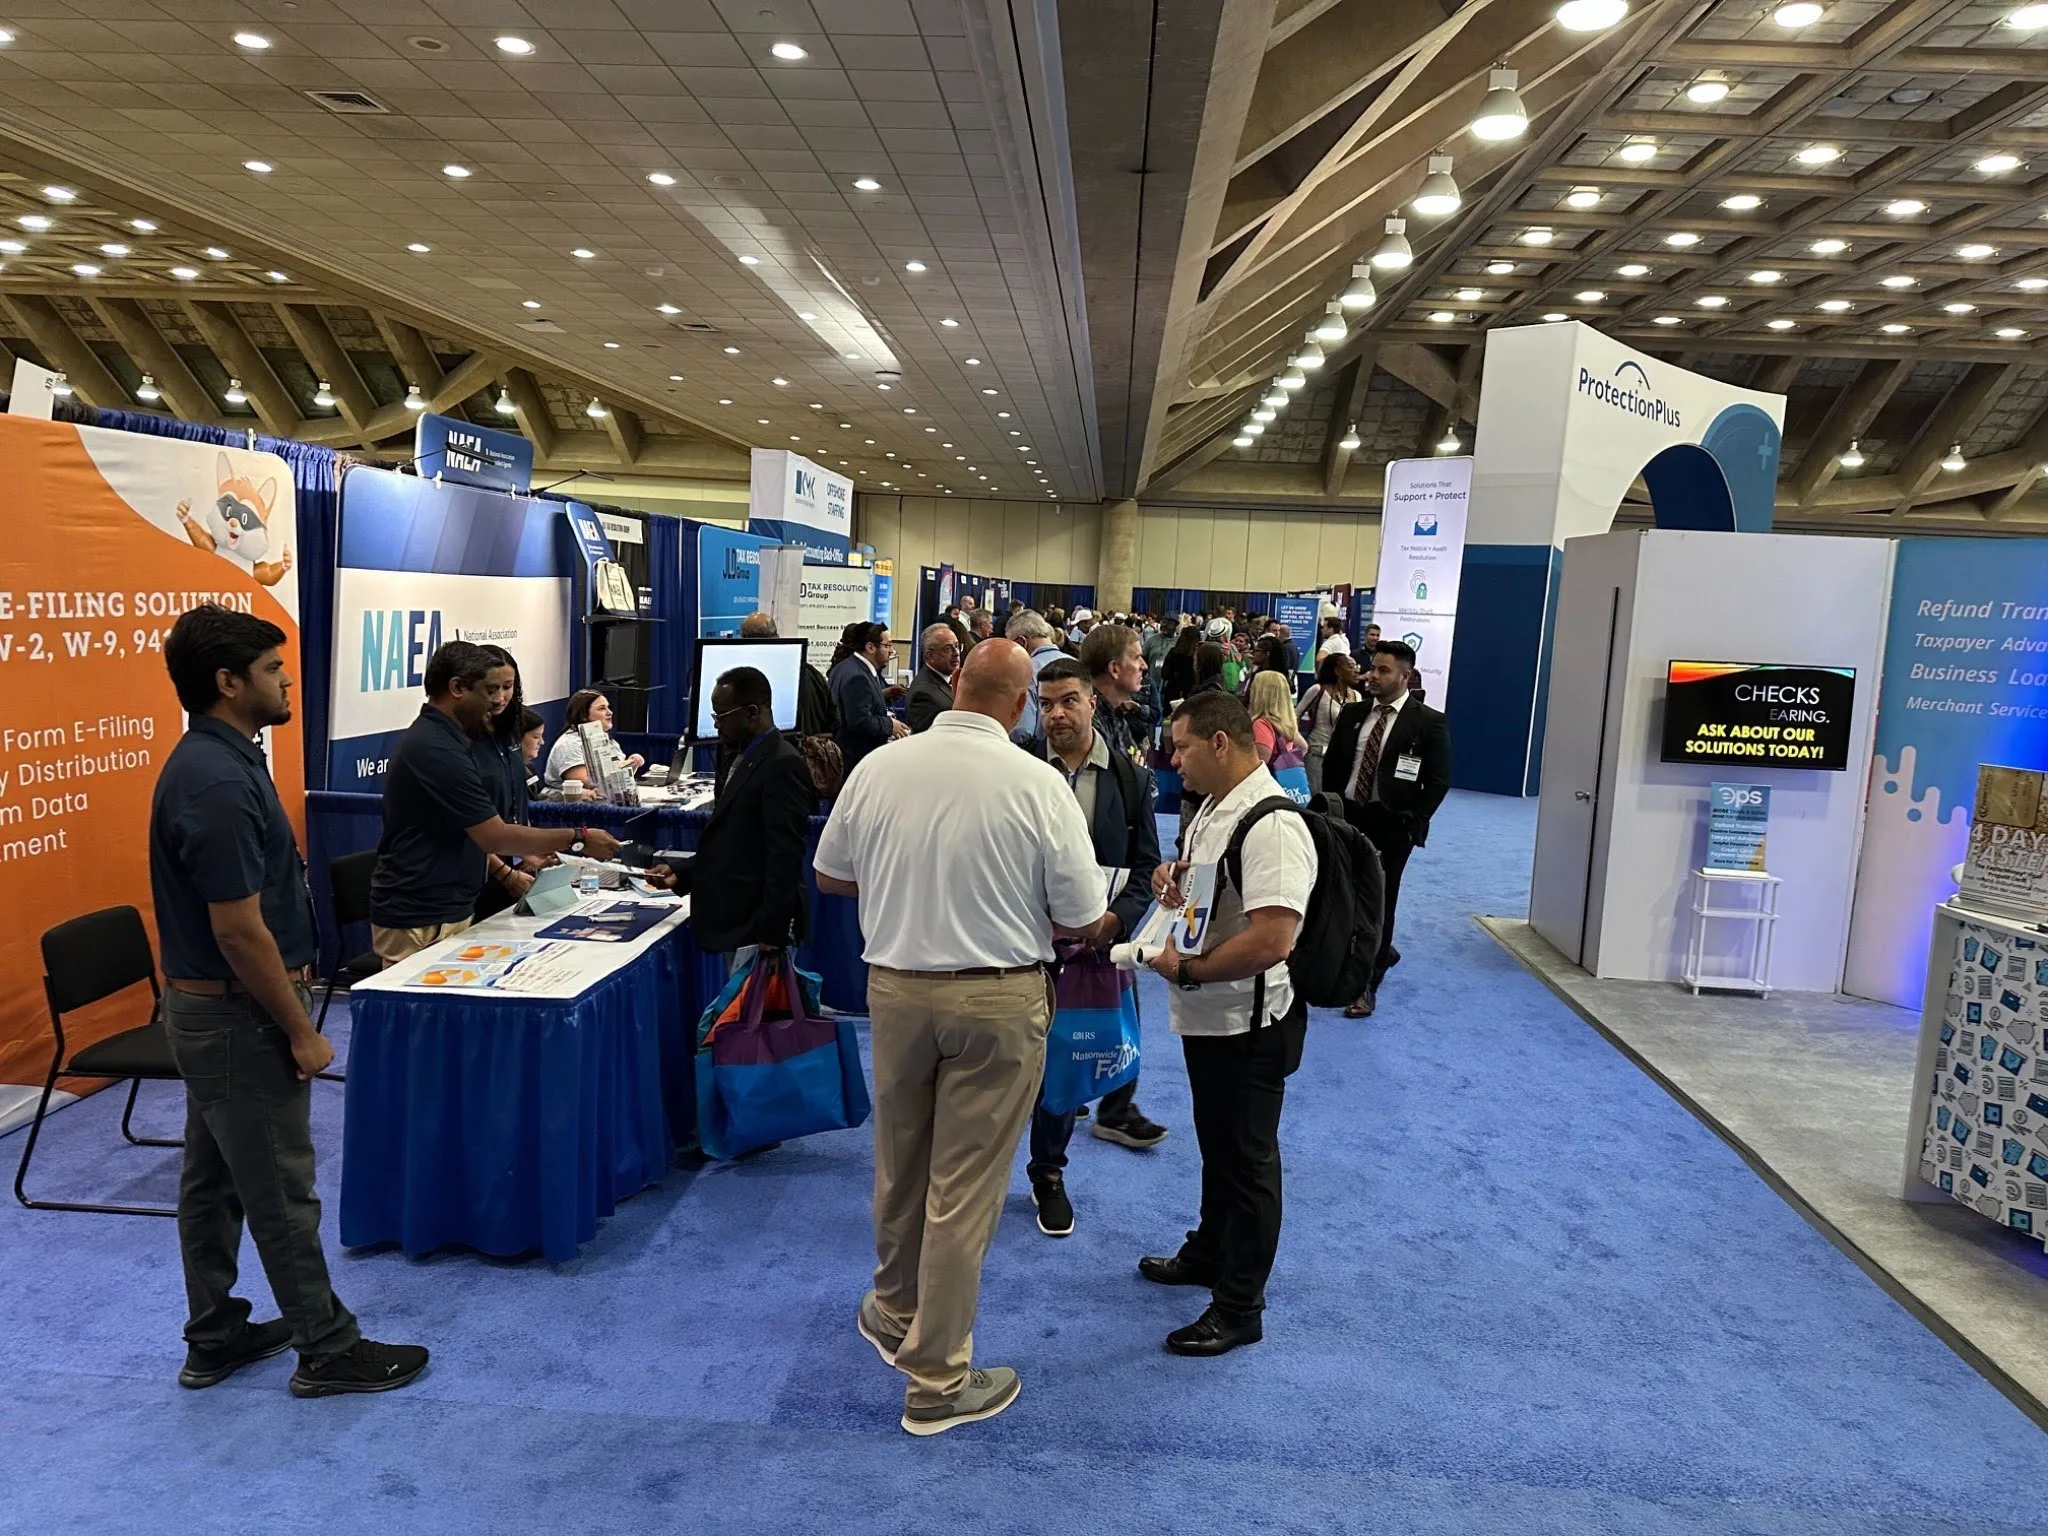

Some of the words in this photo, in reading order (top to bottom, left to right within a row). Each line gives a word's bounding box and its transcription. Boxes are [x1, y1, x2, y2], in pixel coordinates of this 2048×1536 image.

[1578, 367, 1681, 428] ProtectionPlus
[827, 482, 846, 501] OFFSHORE
[1394, 492, 1426, 503] Support
[1435, 491, 1467, 500] Protect
[827, 502, 845, 519] STAFFING
[808, 583, 822, 591] TAX
[824, 584, 868, 592] RESOLUTION
[808, 591, 828, 600] Group
[0, 592, 125, 620] E-FILING
[1917, 600, 1993, 621] Refund
[2001, 602, 2048, 620] Tran
[62, 630, 126, 659] W-9,
[360, 610, 442, 693] NAEA
[464, 629, 488, 641] National
[488, 629, 517, 640] Association
[1915, 633, 1996, 652] Taxpayer
[2000, 636, 2048, 652] Adva
[1910, 663, 1999, 684] Business
[1735, 684, 1820, 704] CHECKS
[1906, 696, 1984, 714] Merchant
[1770, 708, 1830, 724] EARING.
[3, 728, 66, 752] Form
[74, 715, 155, 740] E-Filing
[1697, 723, 1726, 737] ASK
[1730, 725, 1780, 739] ABOUT
[1782, 727, 1815, 742] OUR
[1685, 740, 1765, 756] SOLUTIONS
[1769, 744, 1824, 759] TODAY!
[18, 748, 151, 786] Distribution
[357, 758, 375, 778] We
[32, 793, 89, 819] Data
[1971, 824, 1984, 841] 4
[1081, 1031, 1096, 1040] IRS
[1072, 1050, 1118, 1061] Nationwide
